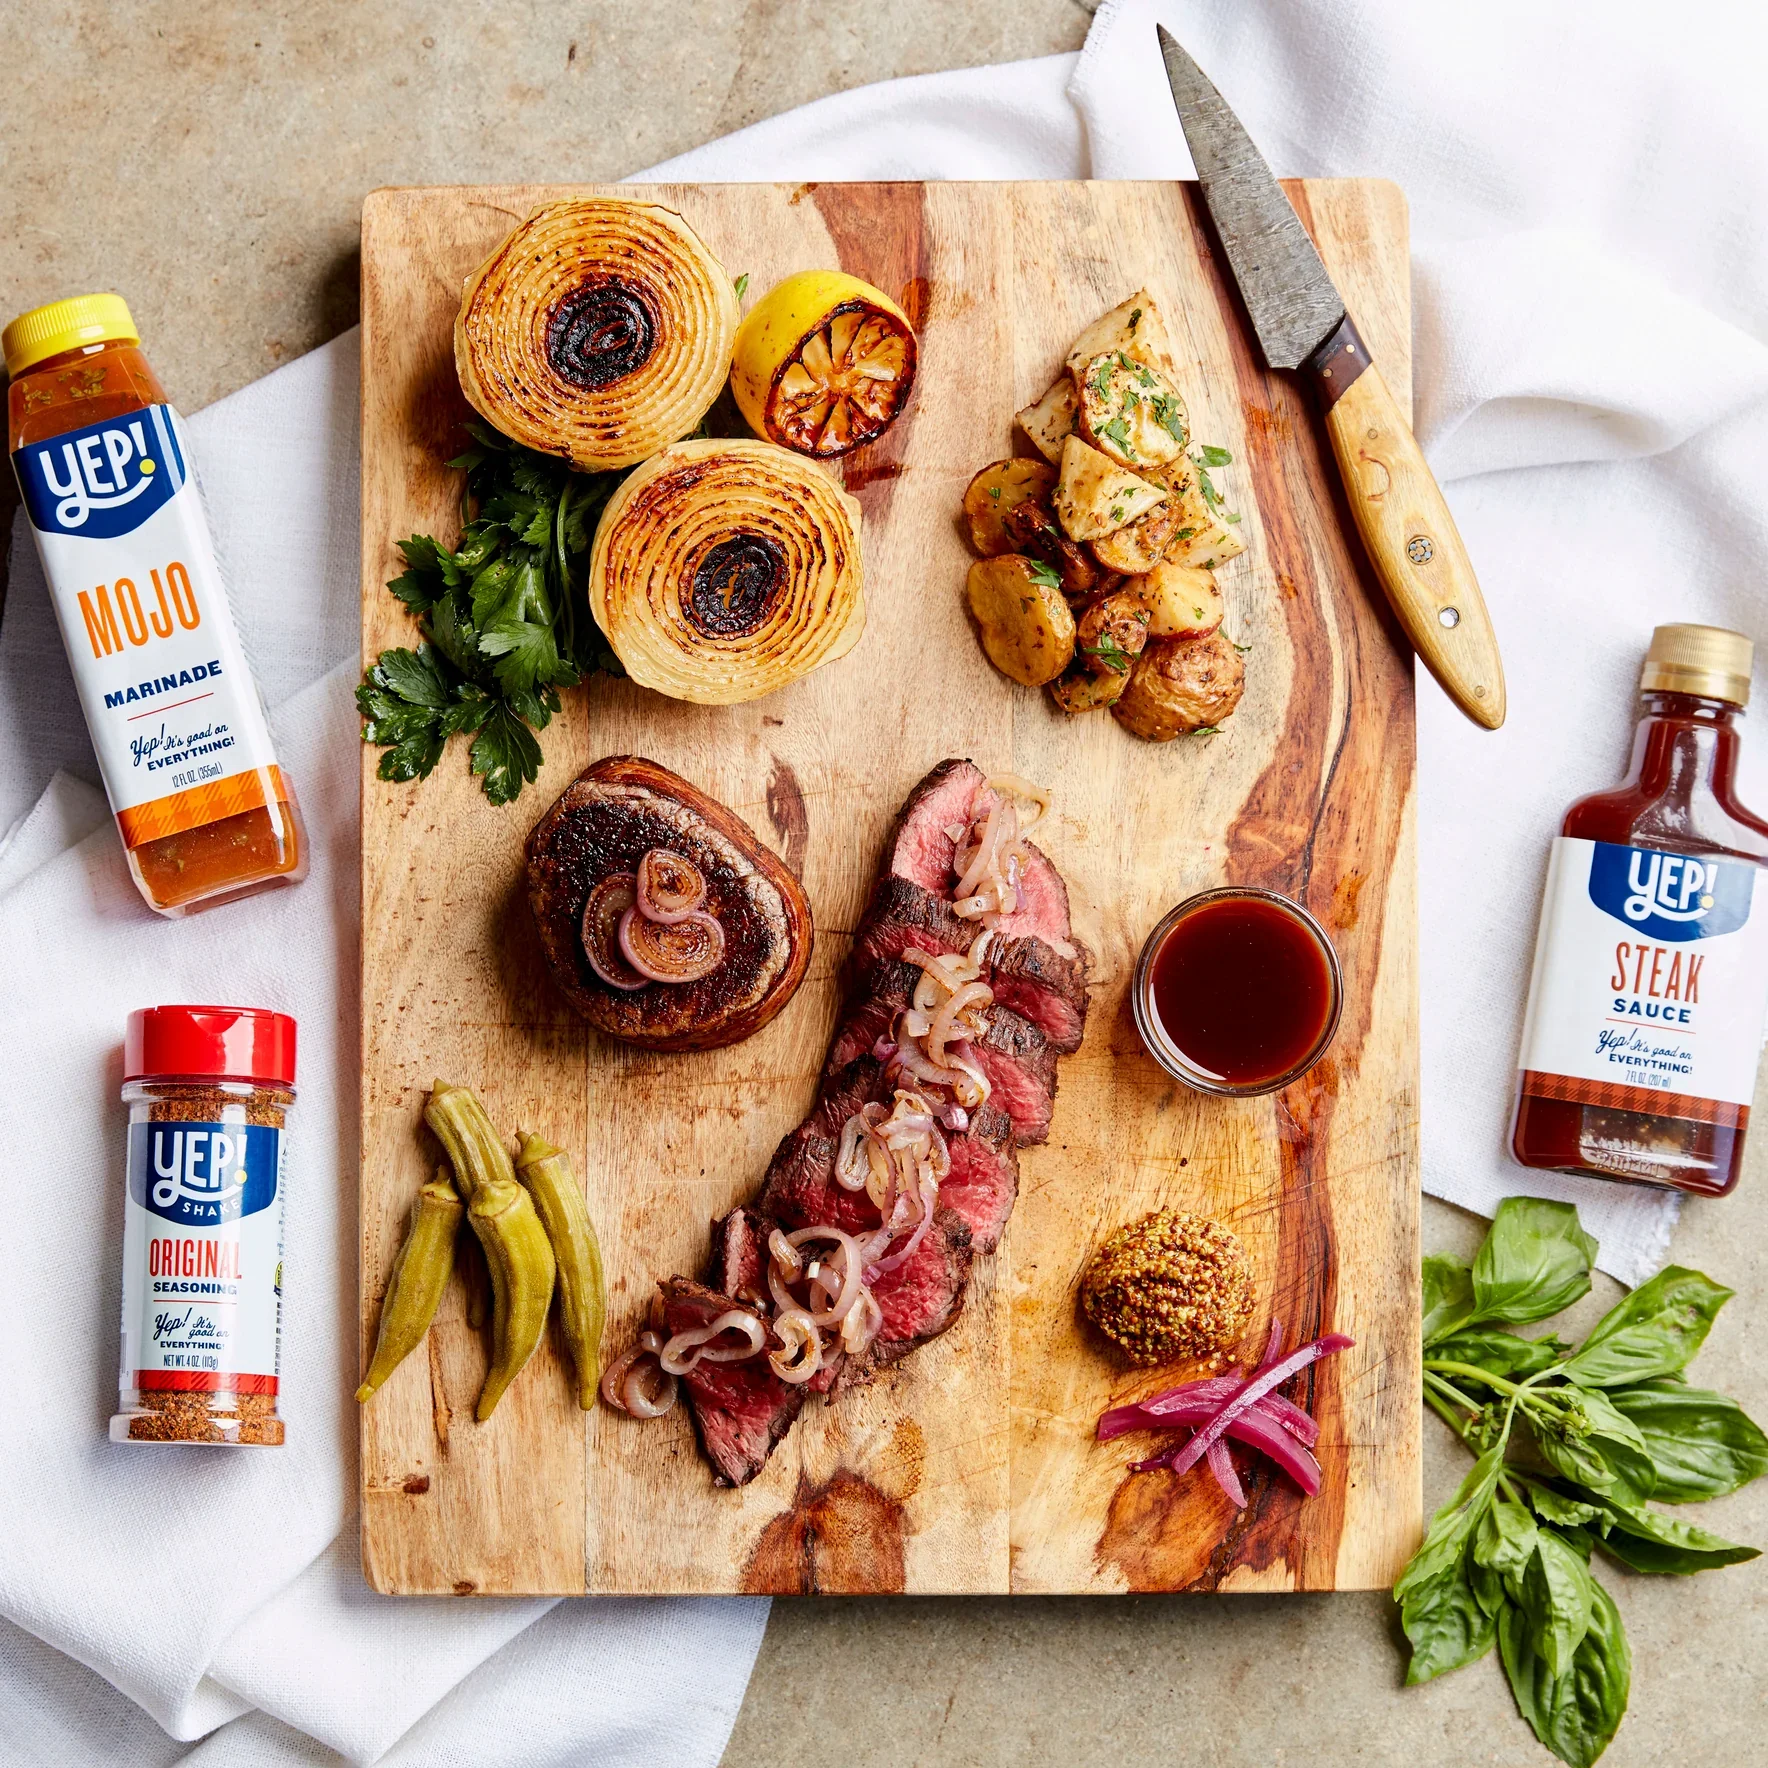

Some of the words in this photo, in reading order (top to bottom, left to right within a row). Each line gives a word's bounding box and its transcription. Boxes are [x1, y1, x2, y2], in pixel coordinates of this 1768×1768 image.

[39, 421, 156, 529] YEP!
[77, 561, 201, 659] MOJO
[103, 660, 223, 709] MARINADE
[130, 723, 165, 767] Yep!
[163, 735, 184, 750] It's
[186, 723, 213, 747] good
[214, 724, 229, 735] on
[147, 736, 235, 771] EVERYTHING!
[171, 775, 180, 788] 12
[179, 773, 188, 786] FL
[1623, 850, 1719, 922] YEP!
[1611, 941, 1705, 1004] STEAK
[1612, 998, 1692, 1023] SAUCE
[1595, 1028, 1638, 1054] Yep!
[1630, 1039, 1650, 1053] It's
[1651, 1046, 1680, 1058] good
[1679, 1051, 1693, 1060] on
[1609, 1053, 1693, 1074] EVERYTHING!
[152, 1131, 248, 1207] YEP!
[182, 1199, 240, 1217] SHAKE
[150, 1238, 242, 1280] ORIGINAL
[153, 1281, 237, 1294] SEASONING
[153, 1307, 193, 1341] Yep!
[192, 1316, 213, 1329] It's
[187, 1325, 216, 1340] good
[216, 1330, 230, 1338] on
[163, 1354, 175, 1367] NET
[186, 1355, 191, 1367] 4
